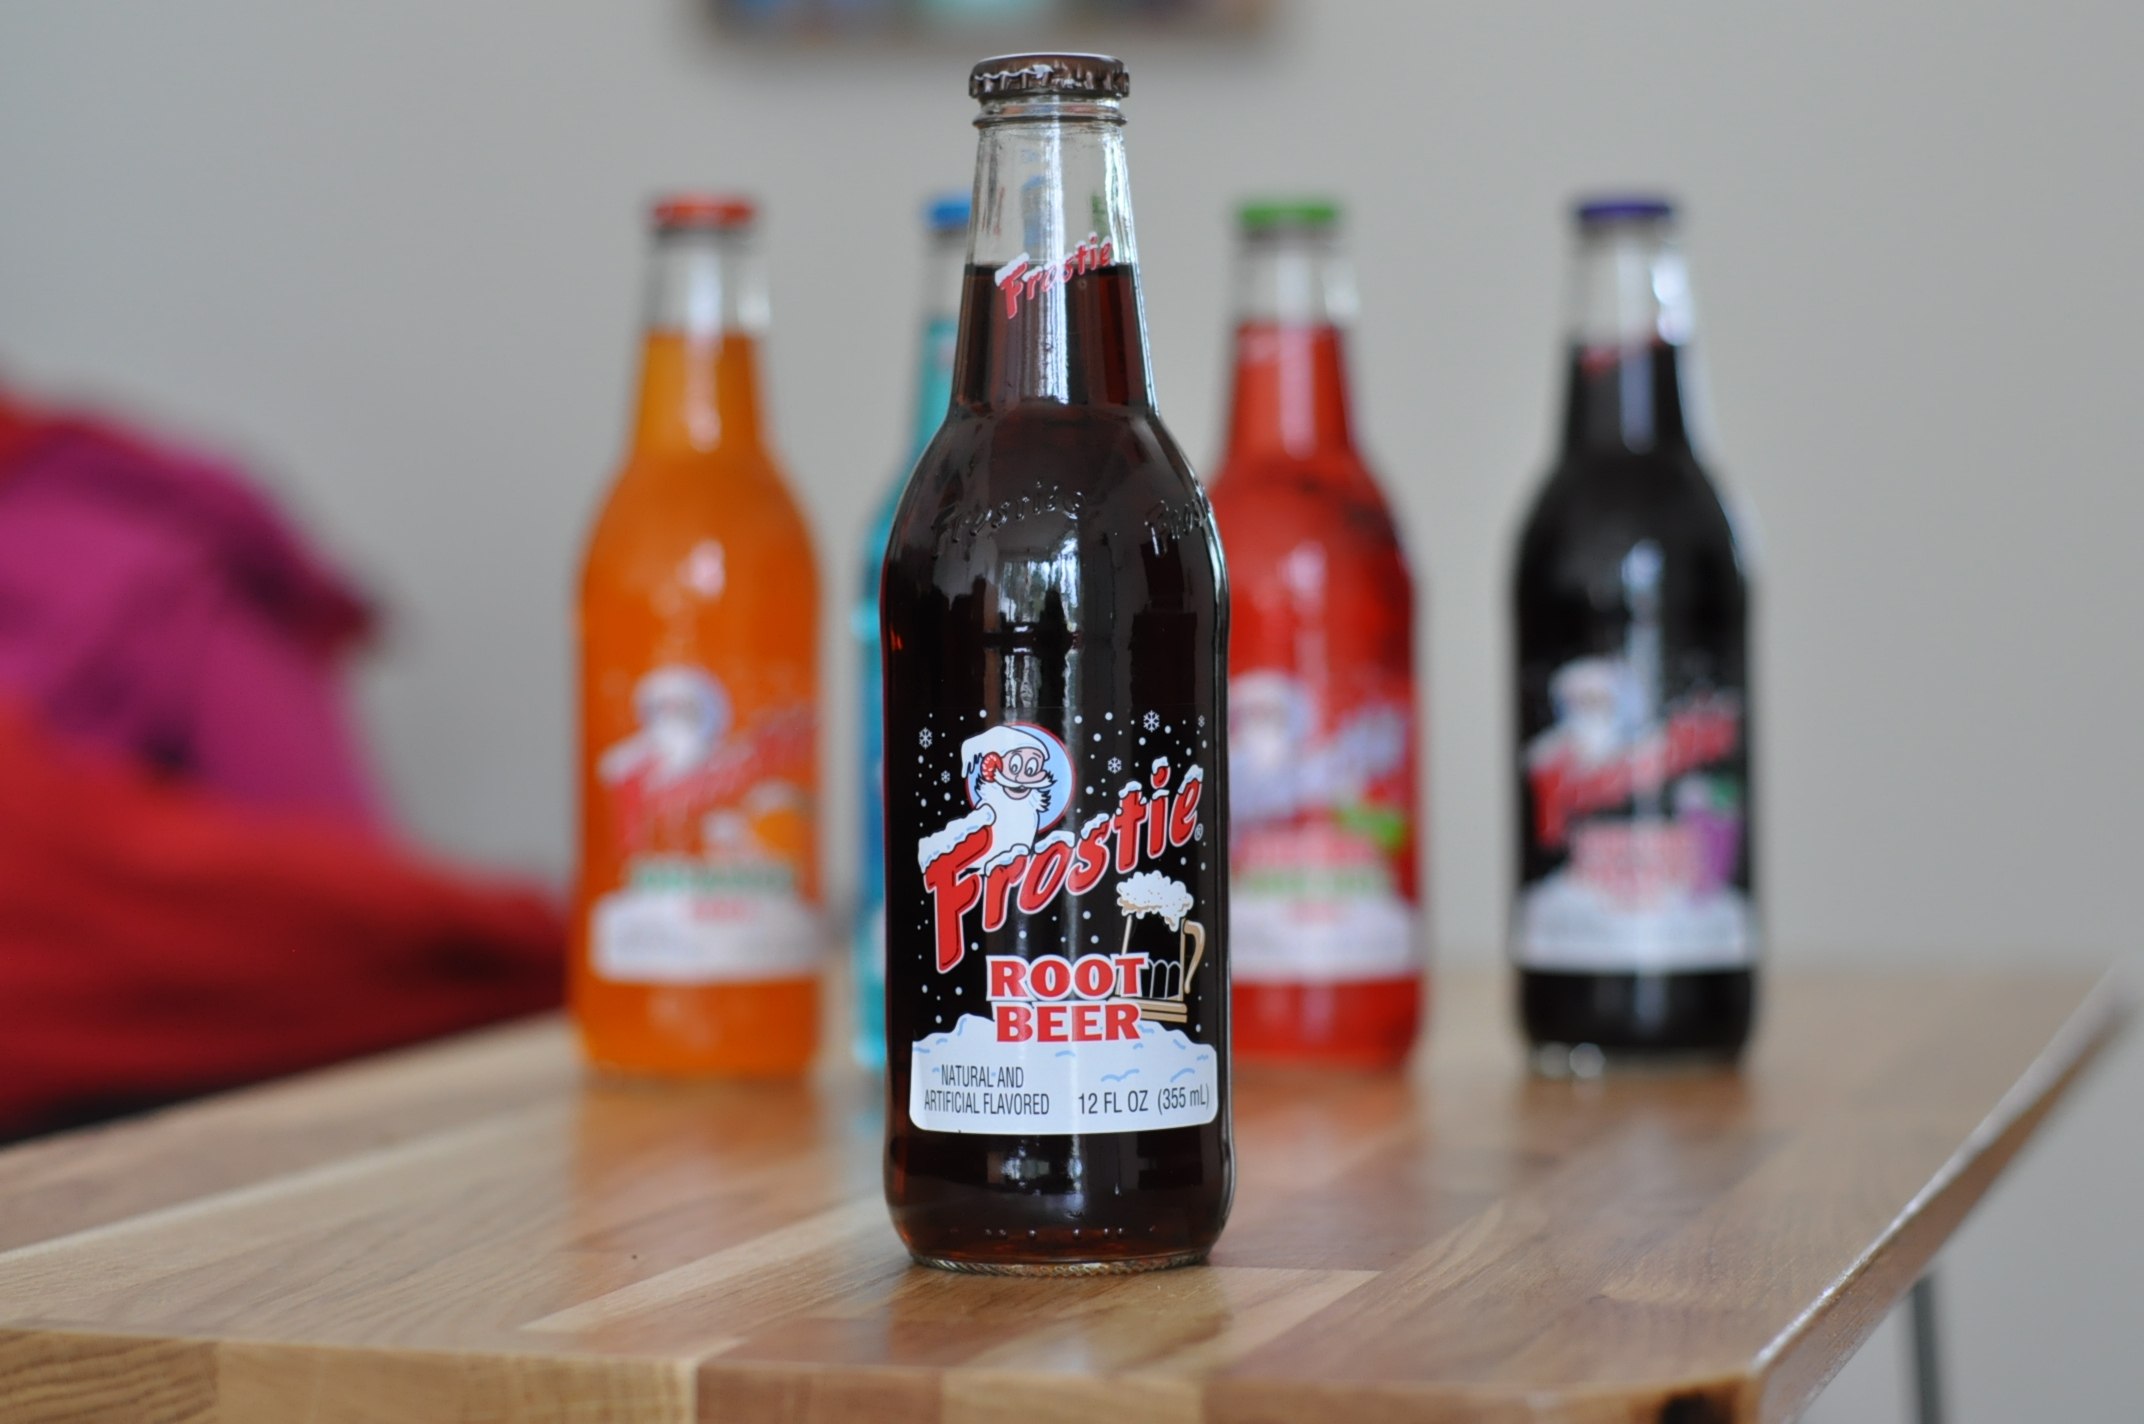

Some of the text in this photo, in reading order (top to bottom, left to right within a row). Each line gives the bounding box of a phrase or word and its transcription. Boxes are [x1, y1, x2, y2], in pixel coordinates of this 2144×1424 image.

[995, 231, 1115, 320] Frostie
[918, 756, 1204, 973] Frostie
[986, 952, 1149, 1001] ROOT
[993, 1002, 1141, 1042] BEER
[940, 1064, 1024, 1088] NATURAL AND
[924, 1089, 1050, 1115] ARTIFICIAL FLAVORED
[1078, 1083, 1211, 1116] 12 FL OZ (355 mL)
